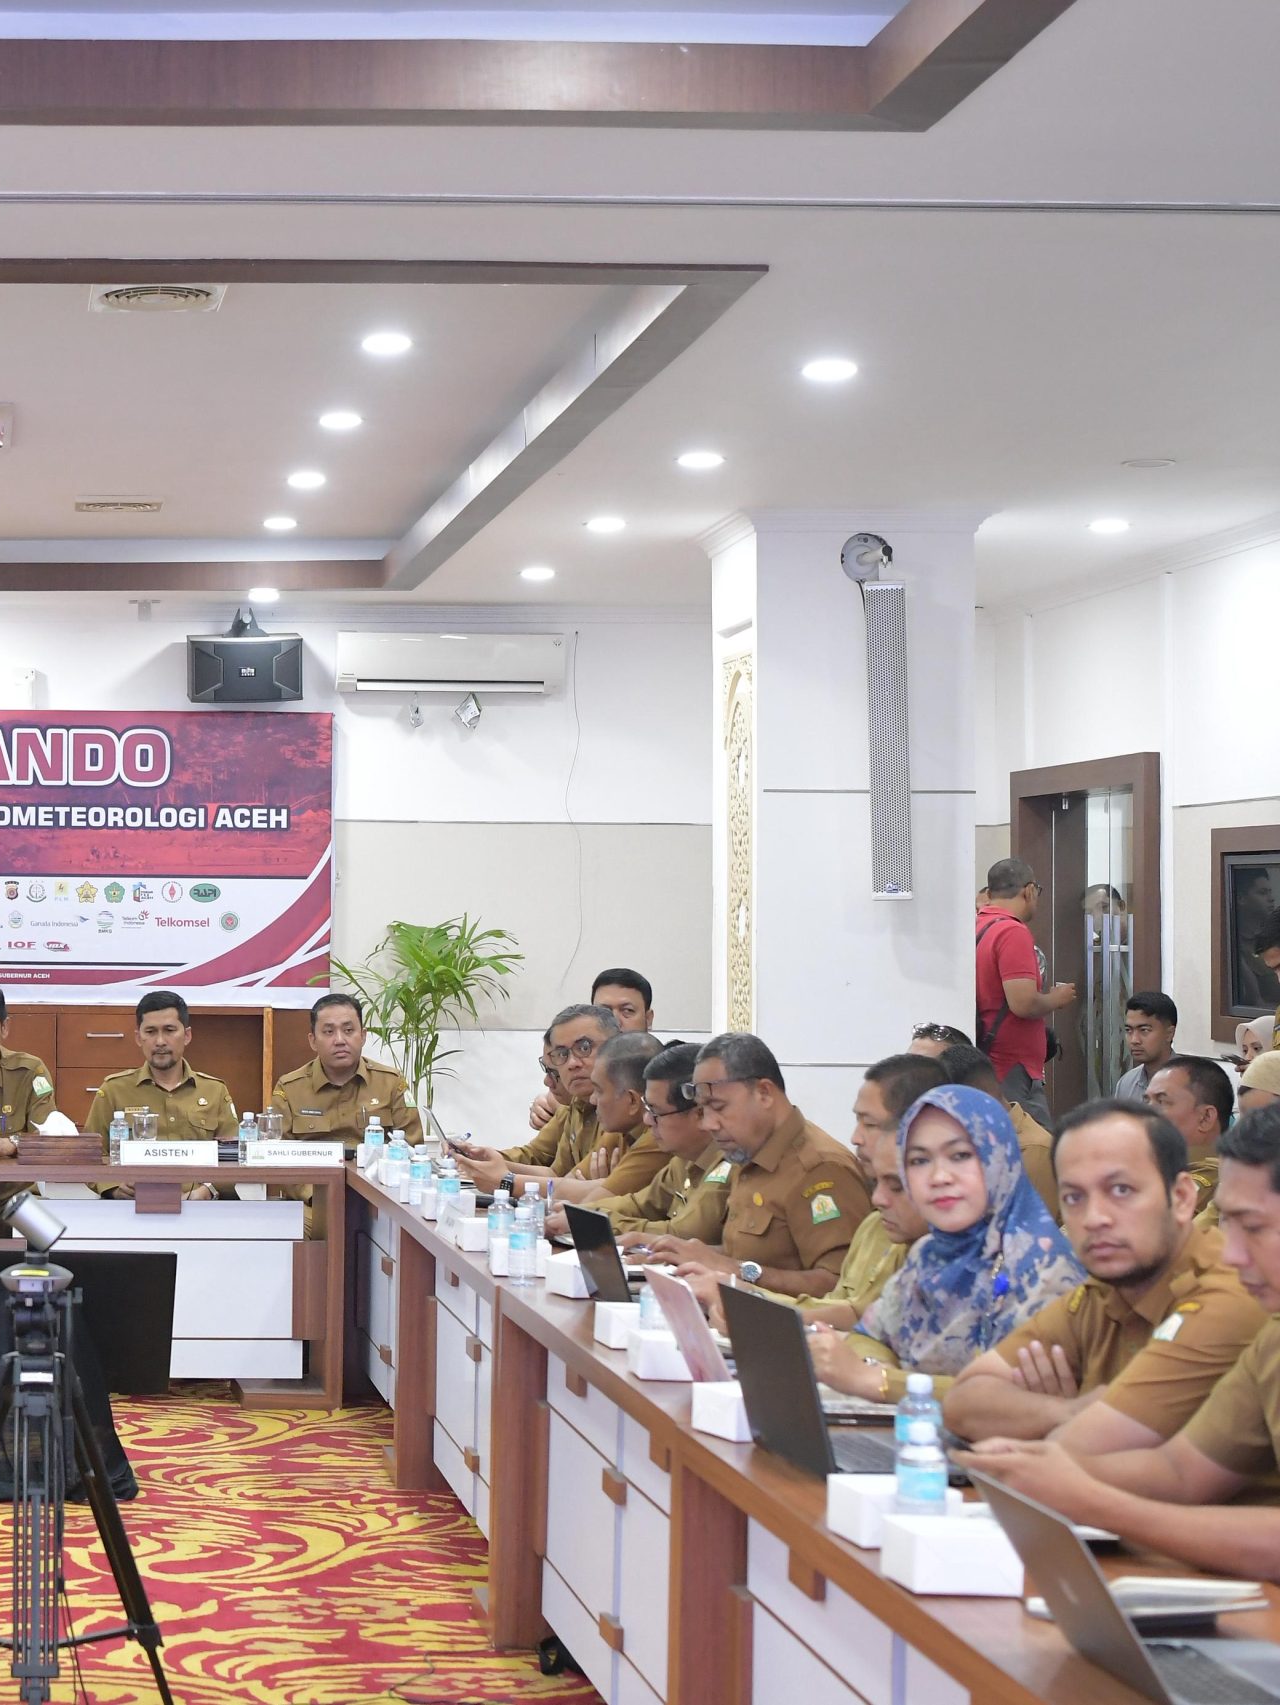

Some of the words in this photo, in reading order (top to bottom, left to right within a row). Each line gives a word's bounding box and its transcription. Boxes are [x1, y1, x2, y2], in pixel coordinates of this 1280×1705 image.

[215, 808, 288, 828] ACEH
[155, 917, 210, 928] Telkomsel
[144, 1149, 189, 1157] ASISTEN
